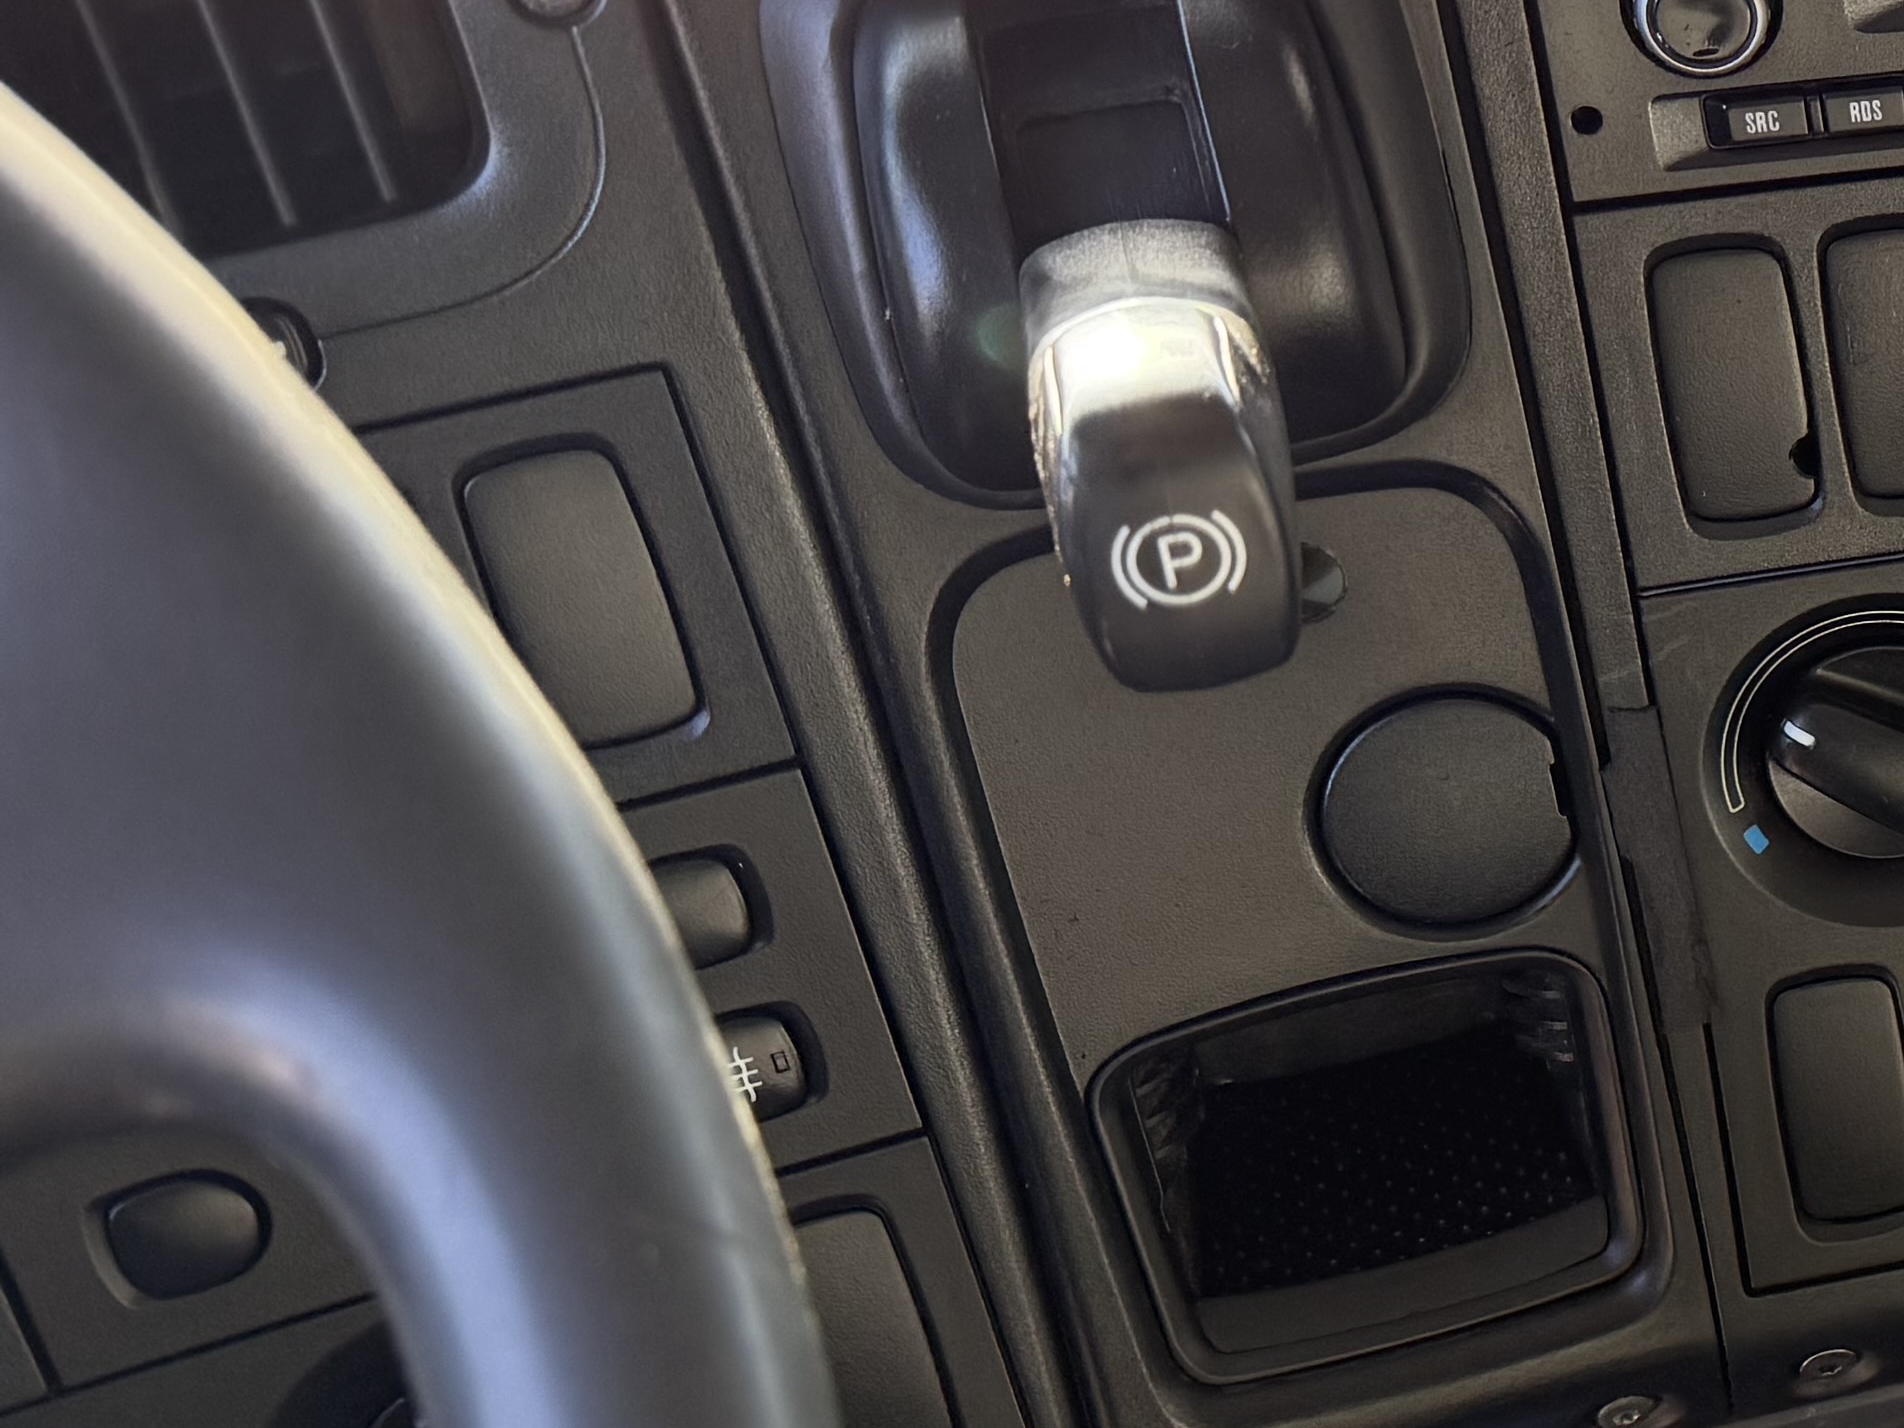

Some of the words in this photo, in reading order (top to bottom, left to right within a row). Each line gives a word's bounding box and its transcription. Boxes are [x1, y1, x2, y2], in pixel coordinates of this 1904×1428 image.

[1745, 110, 1781, 135] SRC
[1849, 98, 1883, 124] RDS
[1156, 531, 1203, 591] P
